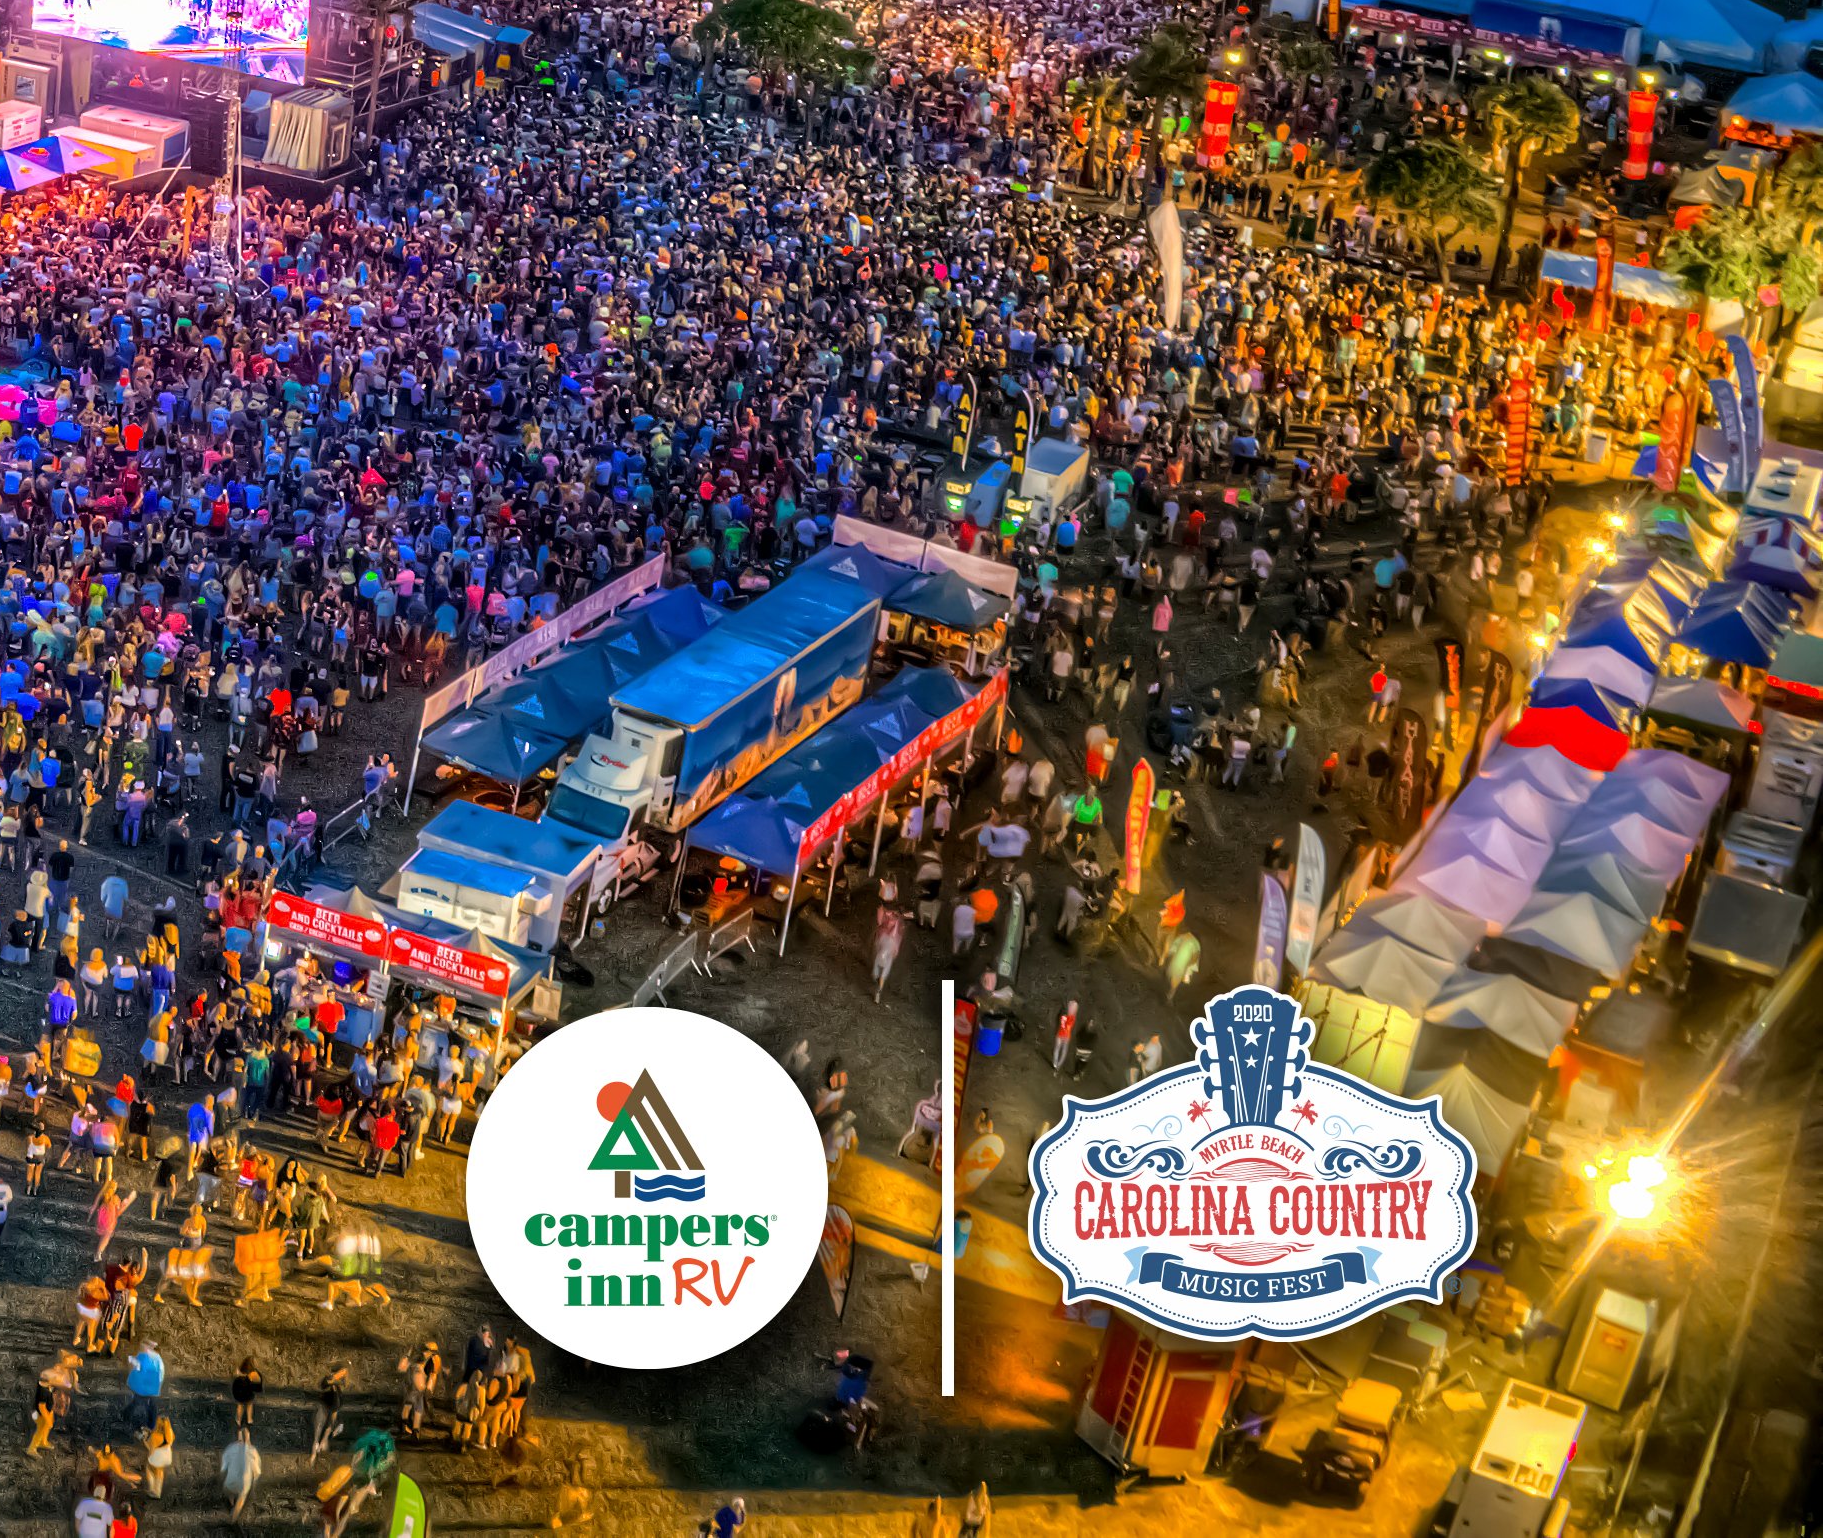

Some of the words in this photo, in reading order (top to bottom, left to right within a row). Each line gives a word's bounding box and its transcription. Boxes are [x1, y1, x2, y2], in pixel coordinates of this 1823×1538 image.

[291, 911, 310, 926] AND
[312, 918, 364, 944] COCKTAILS
[315, 908, 341, 925] BEER
[411, 948, 431, 964] AND
[433, 955, 486, 982] COCKTAILS
[437, 945, 463, 964] BEER
